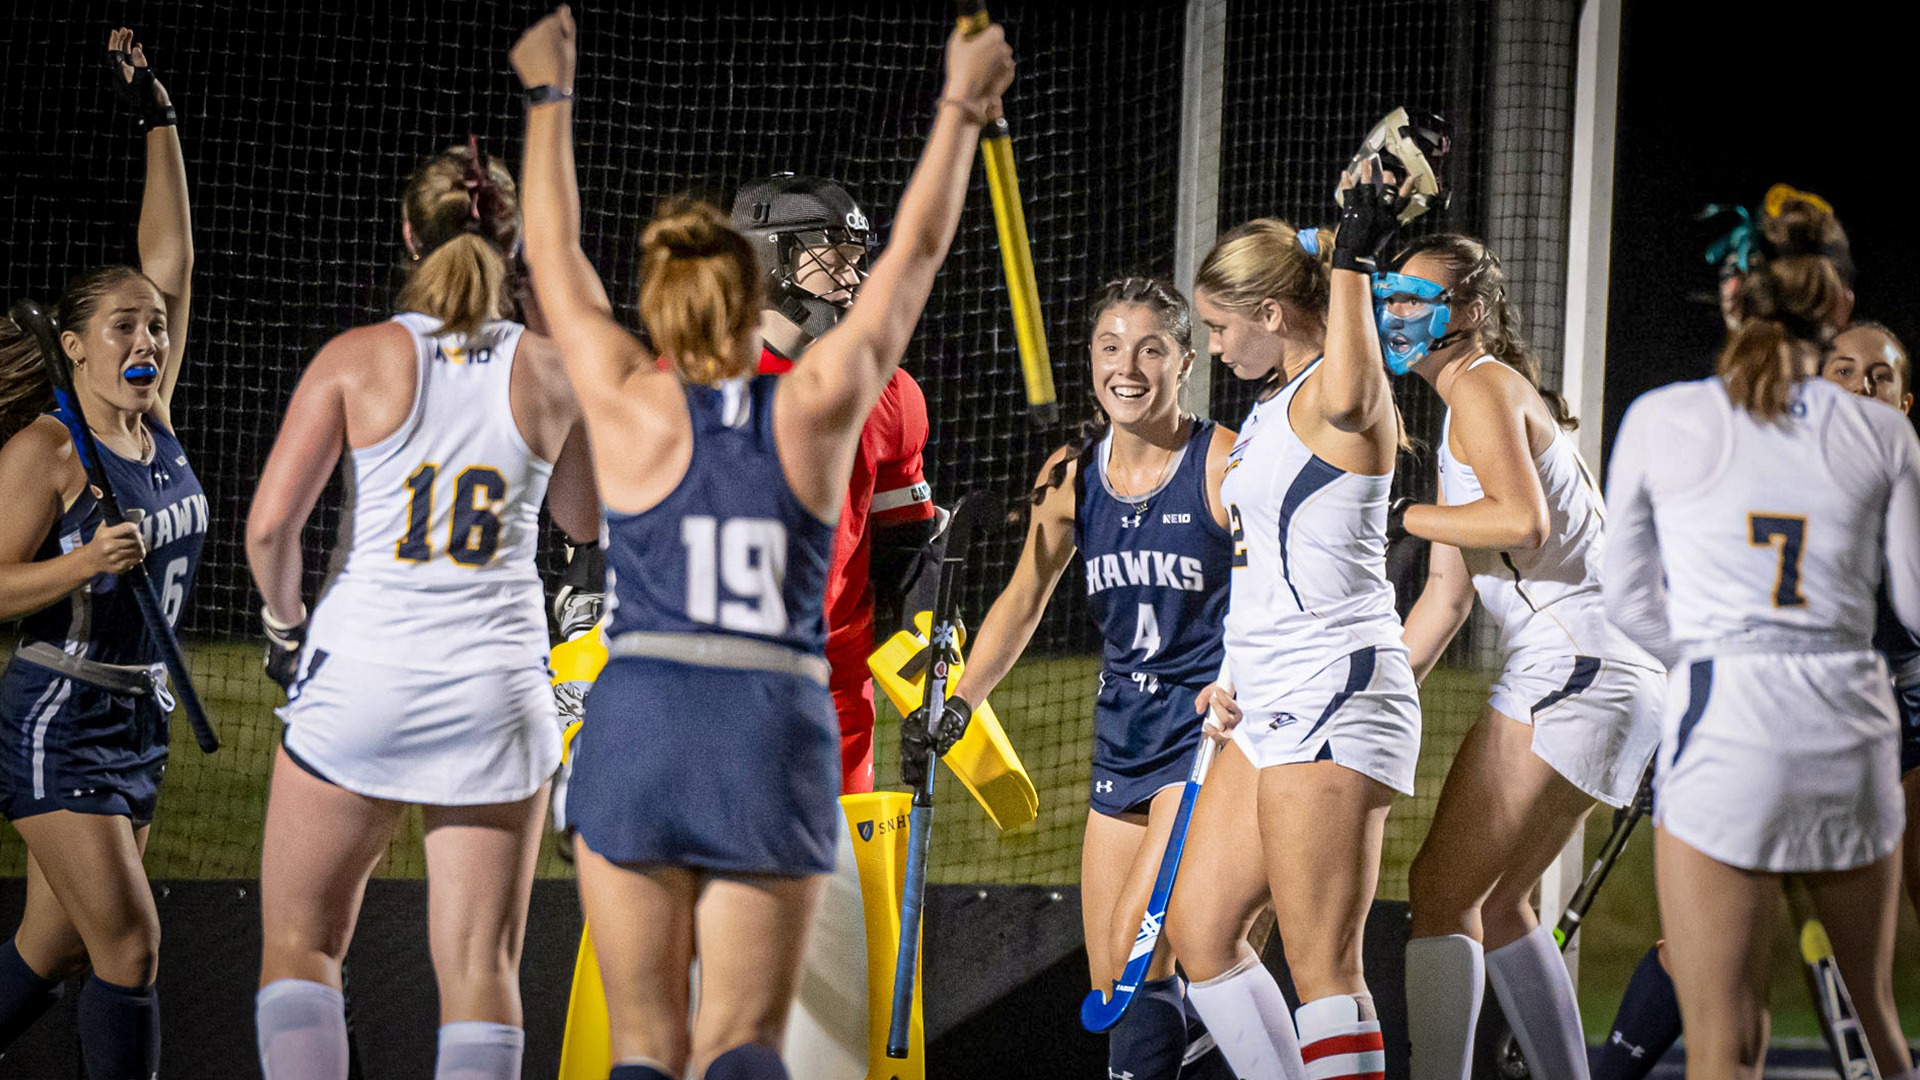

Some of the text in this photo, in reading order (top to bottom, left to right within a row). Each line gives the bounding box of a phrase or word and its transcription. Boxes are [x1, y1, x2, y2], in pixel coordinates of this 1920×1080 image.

[394, 462, 508, 569] 16
[1162, 513, 1191, 524] NE10
[161, 556, 189, 628] 6
[680, 515, 789, 635] 19
[1086, 550, 1205, 597] HAWKS
[1747, 512, 1808, 608] 7
[1132, 602, 1162, 663] 4
[878, 814, 911, 835] SNH
